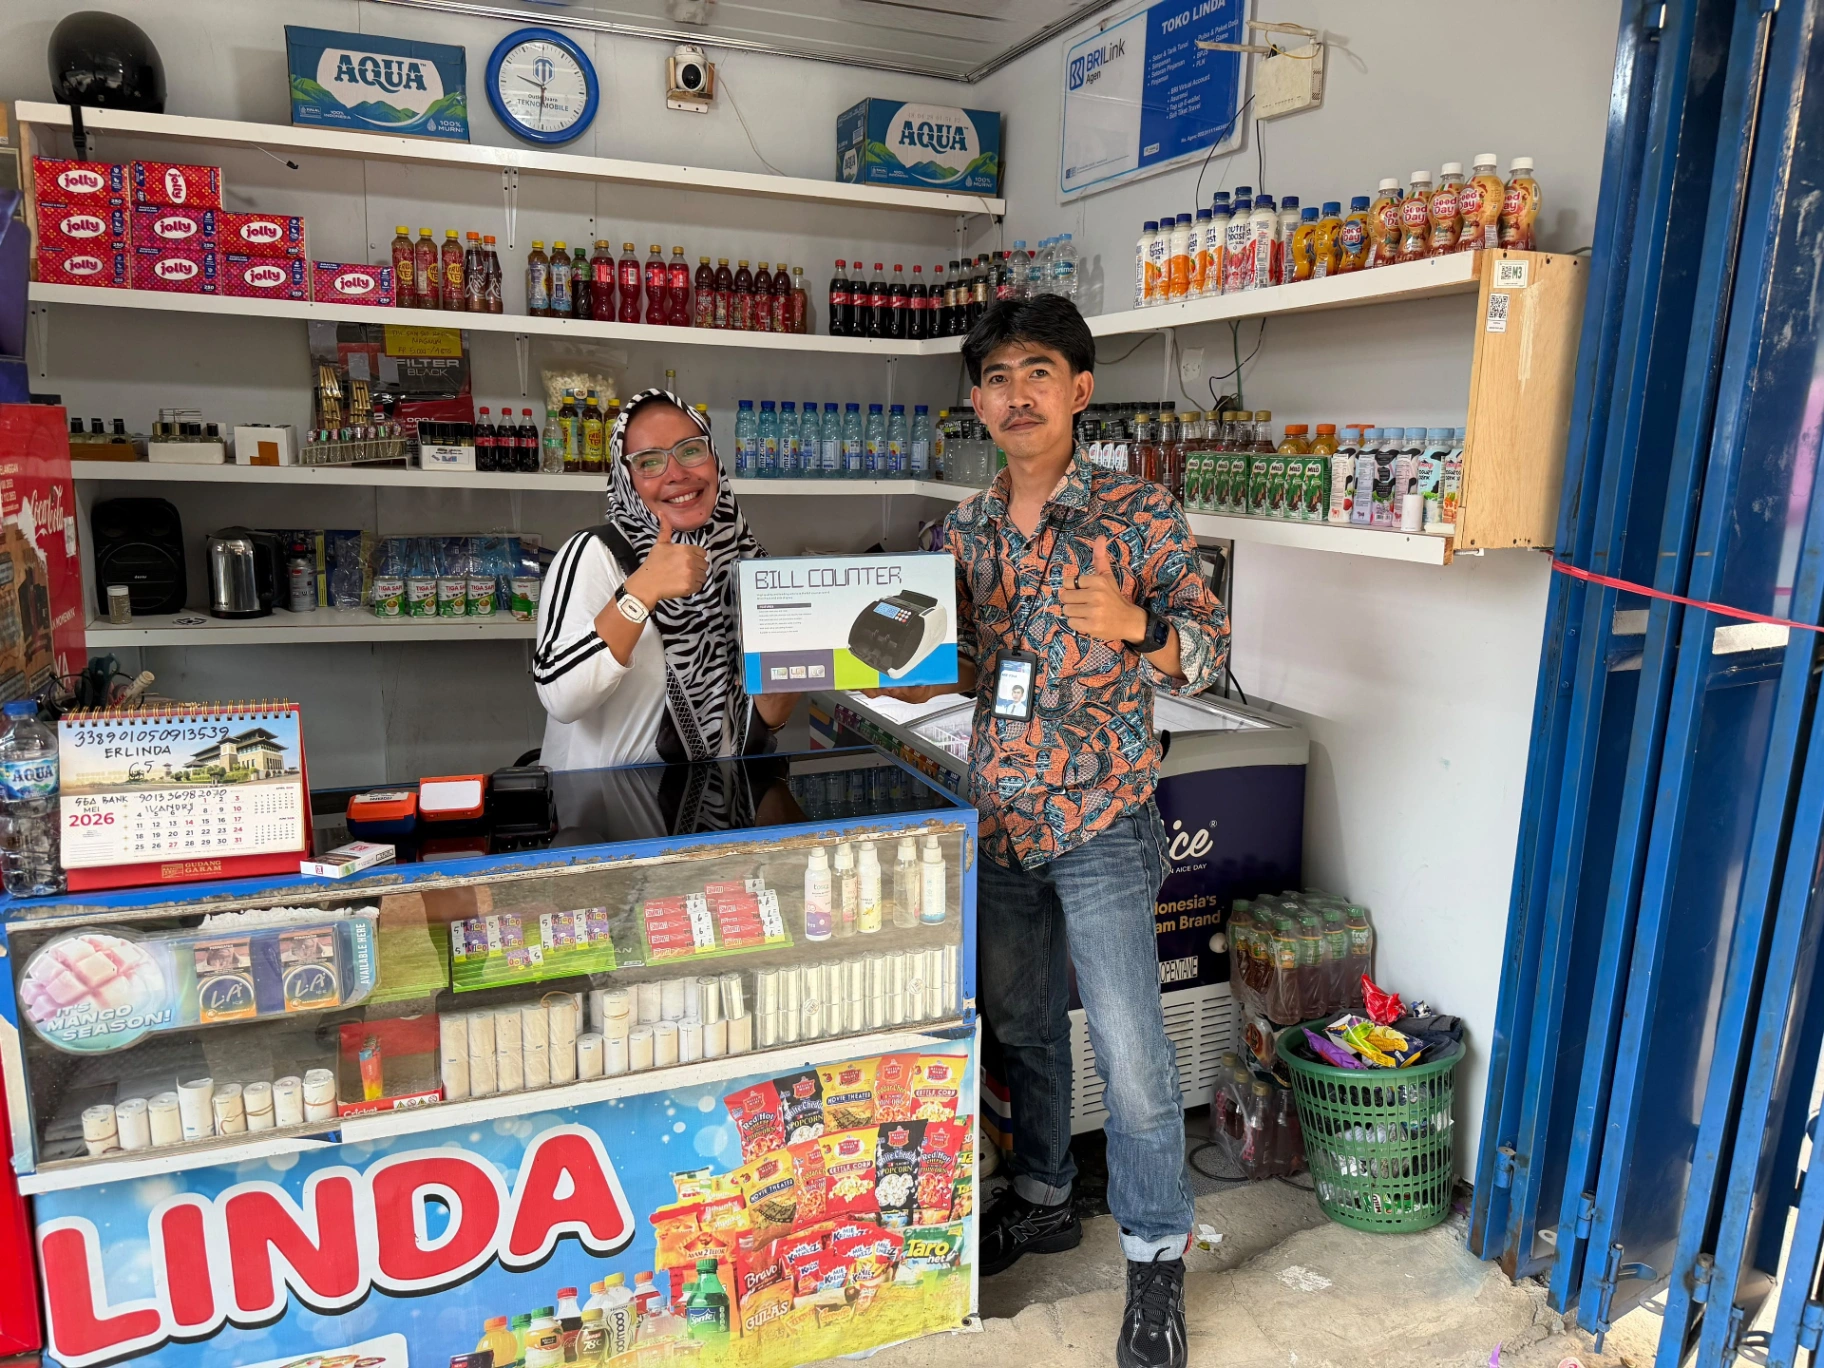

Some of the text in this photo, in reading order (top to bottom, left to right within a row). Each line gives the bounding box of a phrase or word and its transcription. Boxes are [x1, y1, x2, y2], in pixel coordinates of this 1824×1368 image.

[1161, 0, 1226, 34] TOKO LINDA
[1086, 38, 1126, 72] BRILink
[334, 54, 428, 94] AQUA
[1086, 70, 1101, 84] Agen
[898, 120, 968, 154] AQUA
[64, 174, 98, 188] jolly
[168, 172, 182, 200] jolly
[1432, 197, 1457, 208] Good
[1402, 204, 1428, 215] Good
[1434, 204, 1456, 216] Day
[1404, 212, 1426, 224] Day
[66, 219, 100, 234] jolly
[160, 220, 192, 234] jolly
[246, 225, 278, 239] jolly
[1228, 223, 1246, 233] nutri
[1342, 225, 1362, 236] Good
[1343, 232, 1362, 244] Day
[69, 260, 98, 272] jolly
[160, 262, 192, 275] jolly
[250, 270, 281, 284] jolly
[1512, 266, 1522, 280] M3
[340, 276, 370, 290] jolly
[396, 358, 460, 368] FILTER
[408, 368, 448, 376] BLACK
[1254, 464, 1266, 472] MILO
[1271, 464, 1284, 472] MILO
[1288, 464, 1302, 472] MILO
[1307, 466, 1320, 474] MILO
[755, 566, 902, 590] BILL COUNTER
[104, 746, 172, 759] ERLINDA
[12, 765, 54, 783] AQUA
[68, 812, 115, 828] 2026
[185, 866, 222, 874] GARAM
[1193, 863, 1207, 871] DAY
[577, 914, 583, 922] 5
[1180, 910, 1221, 930] Brand
[543, 941, 549, 951] 5
[356, 922, 370, 984] AVAILABLE HERE
[56, 1002, 91, 1018] IT'S
[46, 1004, 133, 1033] MANGO
[62, 1009, 172, 1042] SEASON!
[827, 1091, 872, 1104] MOVIE THEATER
[938, 1089, 956, 1097] CORN
[852, 1161, 871, 1169] CORN
[750, 1180, 794, 1201] MOVIE THEATER
[40, 1130, 628, 1360] LINDA
[907, 1239, 950, 1259] Taro
[690, 1314, 714, 1325] Sprite
